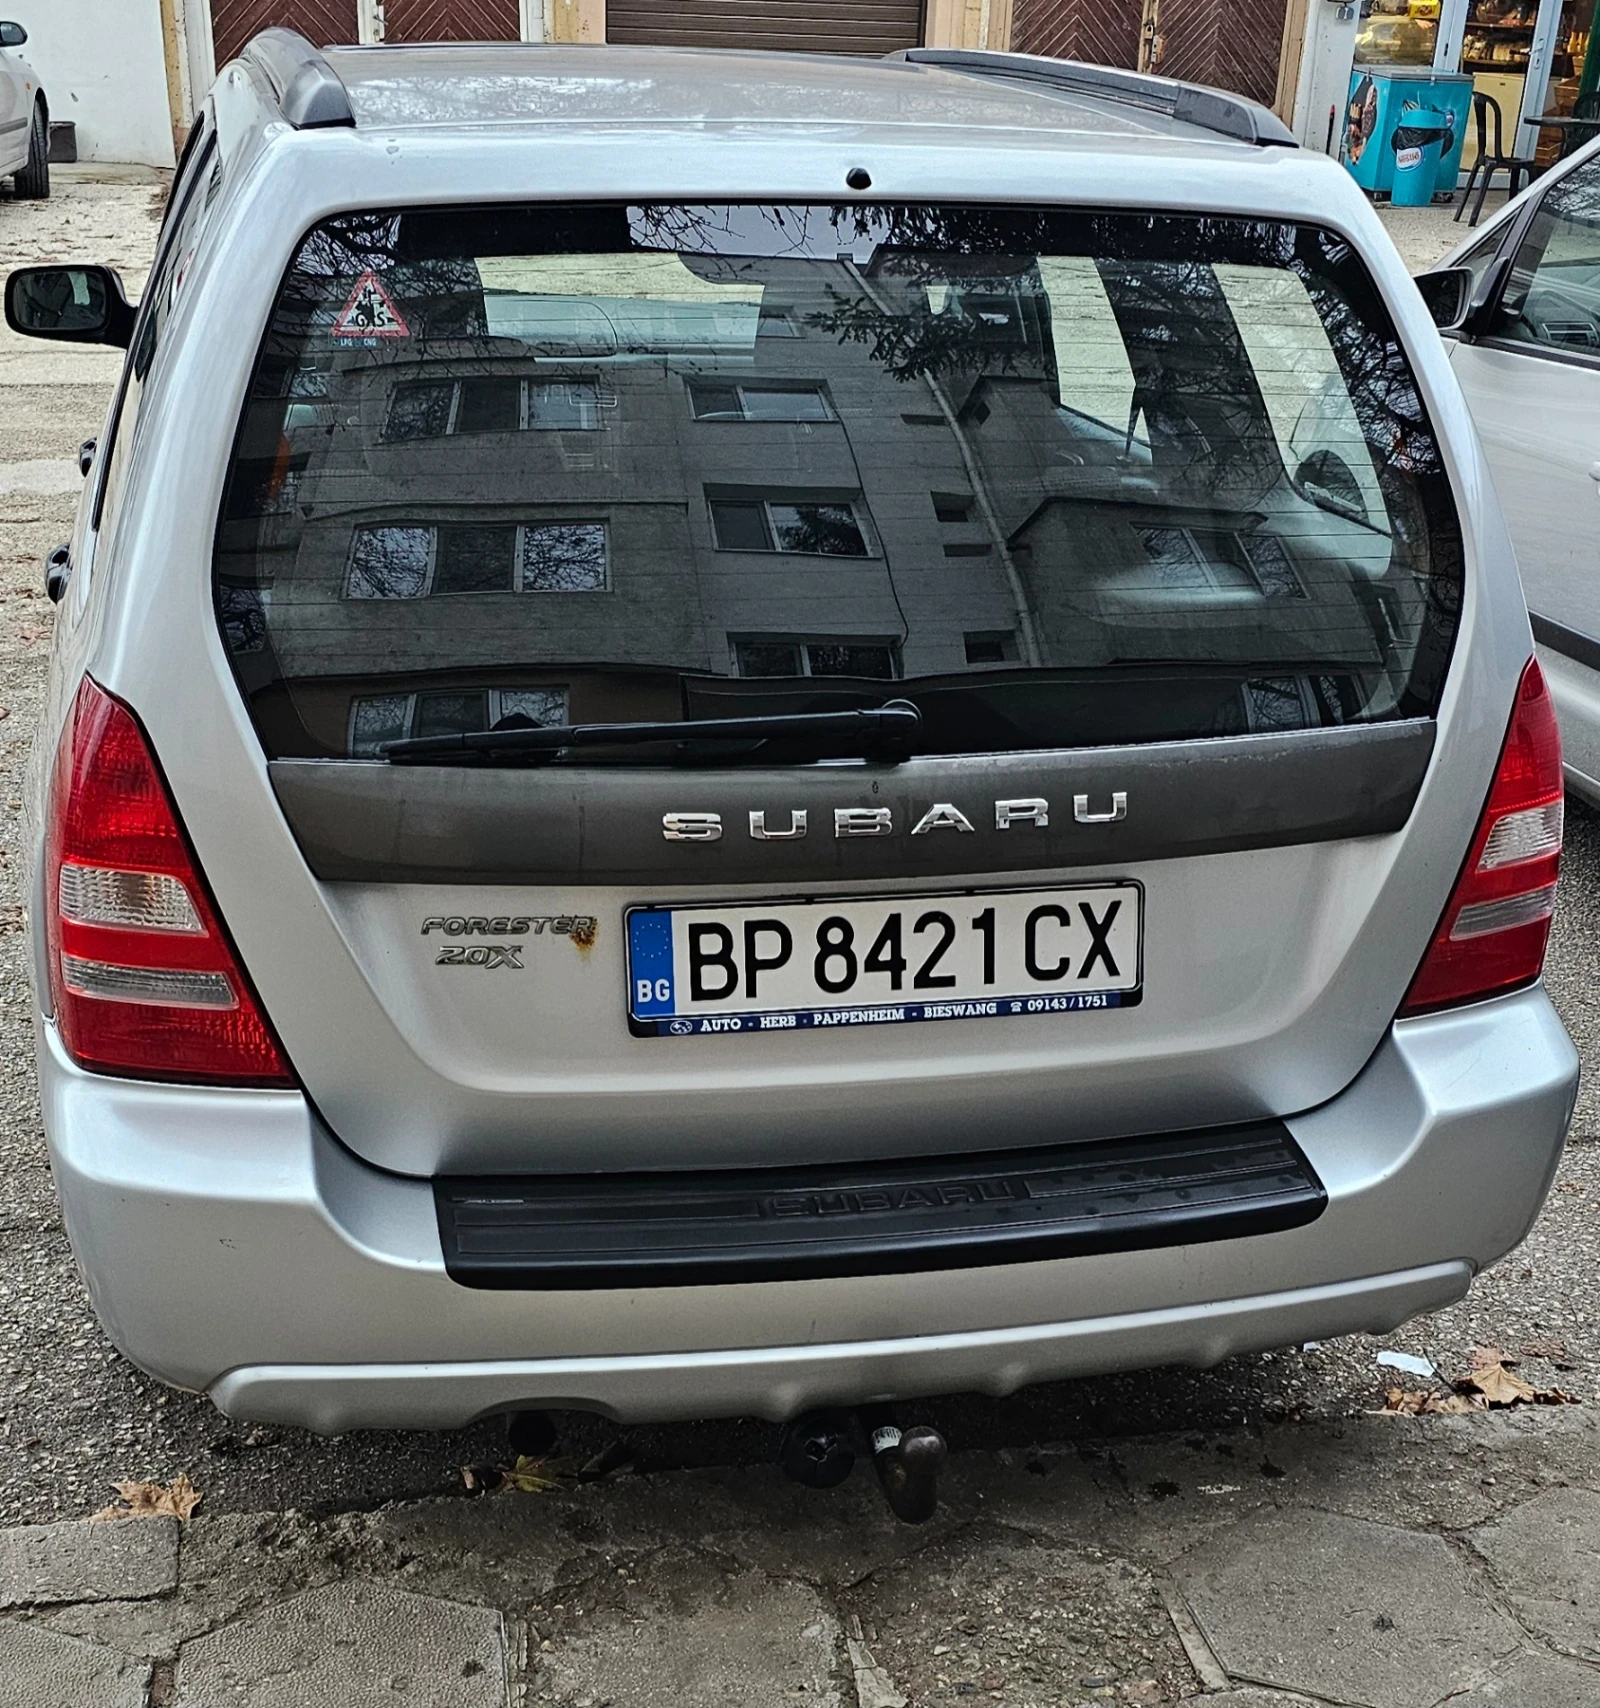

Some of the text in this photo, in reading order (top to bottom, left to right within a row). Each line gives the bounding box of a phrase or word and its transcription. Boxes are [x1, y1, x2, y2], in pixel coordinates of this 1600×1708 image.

[662, 791, 1127, 842] SUBARU
[420, 915, 596, 936] FORESTER
[435, 944, 525, 969] 20X
[688, 899, 1123, 1002] BP 8421 CX
[636, 979, 670, 1003] BG
[700, 1018, 742, 1032] AUTO
[760, 1015, 797, 1029] HERB
[813, 1008, 905, 1025] PAPPENHEIM
[923, 1002, 998, 1018] BIESWANG
[771, 1180, 1016, 1217] SUBARU
